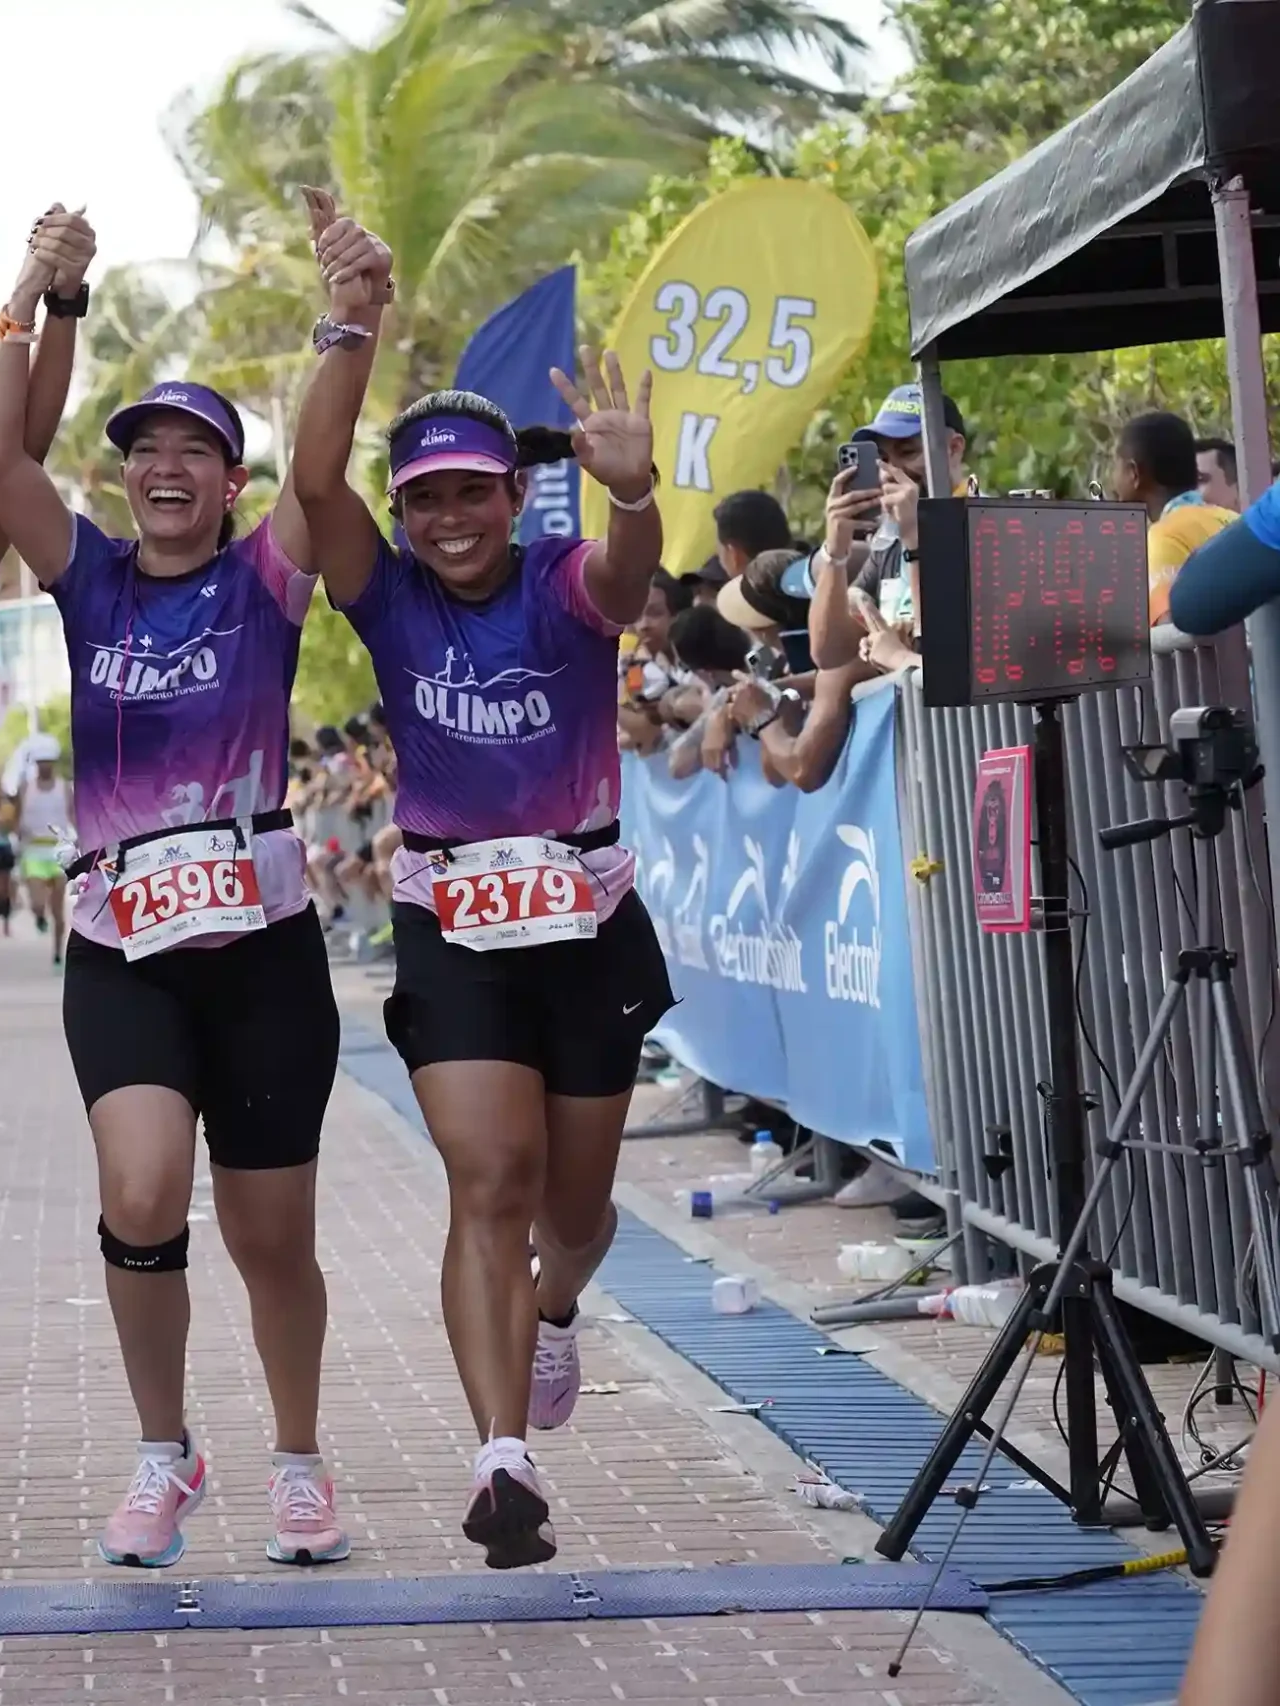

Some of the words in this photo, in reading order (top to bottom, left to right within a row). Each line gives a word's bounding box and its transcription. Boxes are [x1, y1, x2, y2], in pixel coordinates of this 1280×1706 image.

[650, 280, 816, 395] 32,5
[421, 434, 456, 447] OLIMPO
[673, 411, 721, 493] K
[174, 679, 220, 697] Funcional
[415, 680, 551, 735] OLIMPO
[446, 729, 514, 745] Entrenamiento
[122, 861, 245, 933] 2596
[447, 868, 576, 928] 2379
